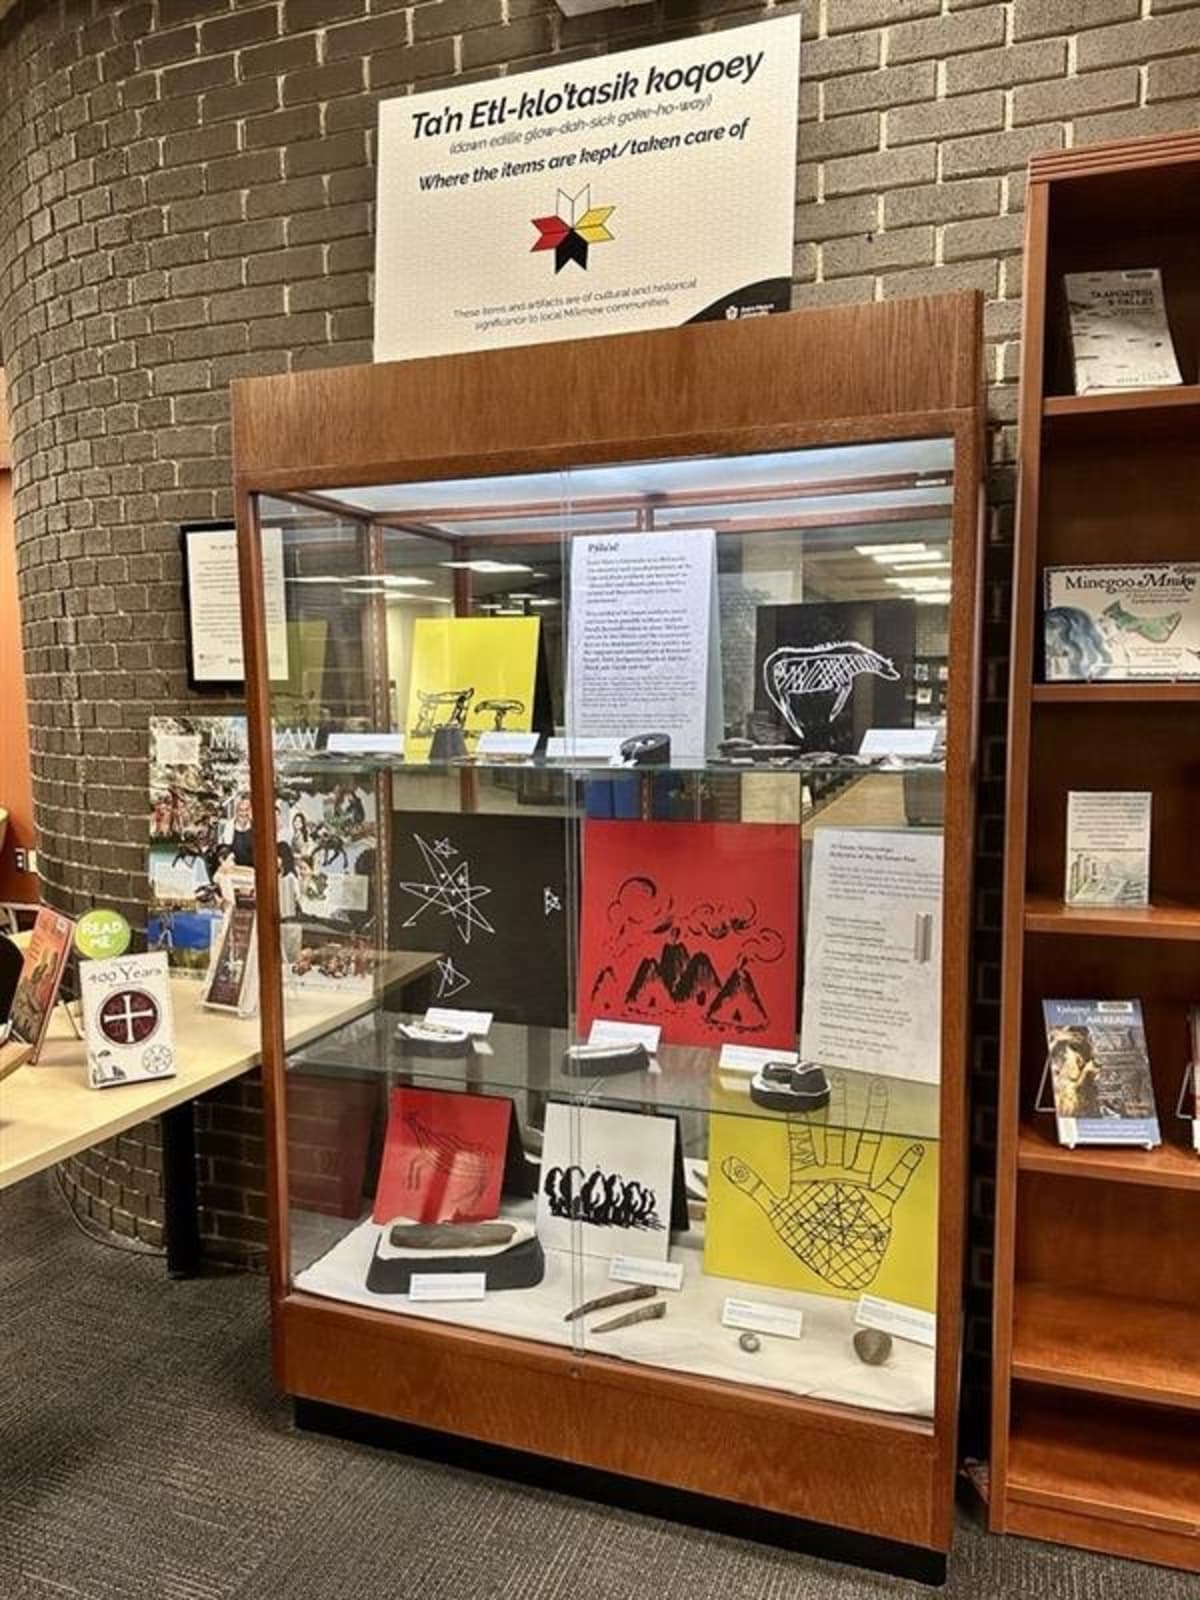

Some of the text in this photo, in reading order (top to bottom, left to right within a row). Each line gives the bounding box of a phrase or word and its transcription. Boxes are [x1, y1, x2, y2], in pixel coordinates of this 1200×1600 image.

[412, 51, 764, 139] Ta'n Etl-klo'tasik koqoey
[419, 117, 751, 191] Where the items are kept/taken care of
[582, 291, 593, 303] of
[1065, 575, 1135, 594] Minegoo
[119, 966, 163, 981] Years
